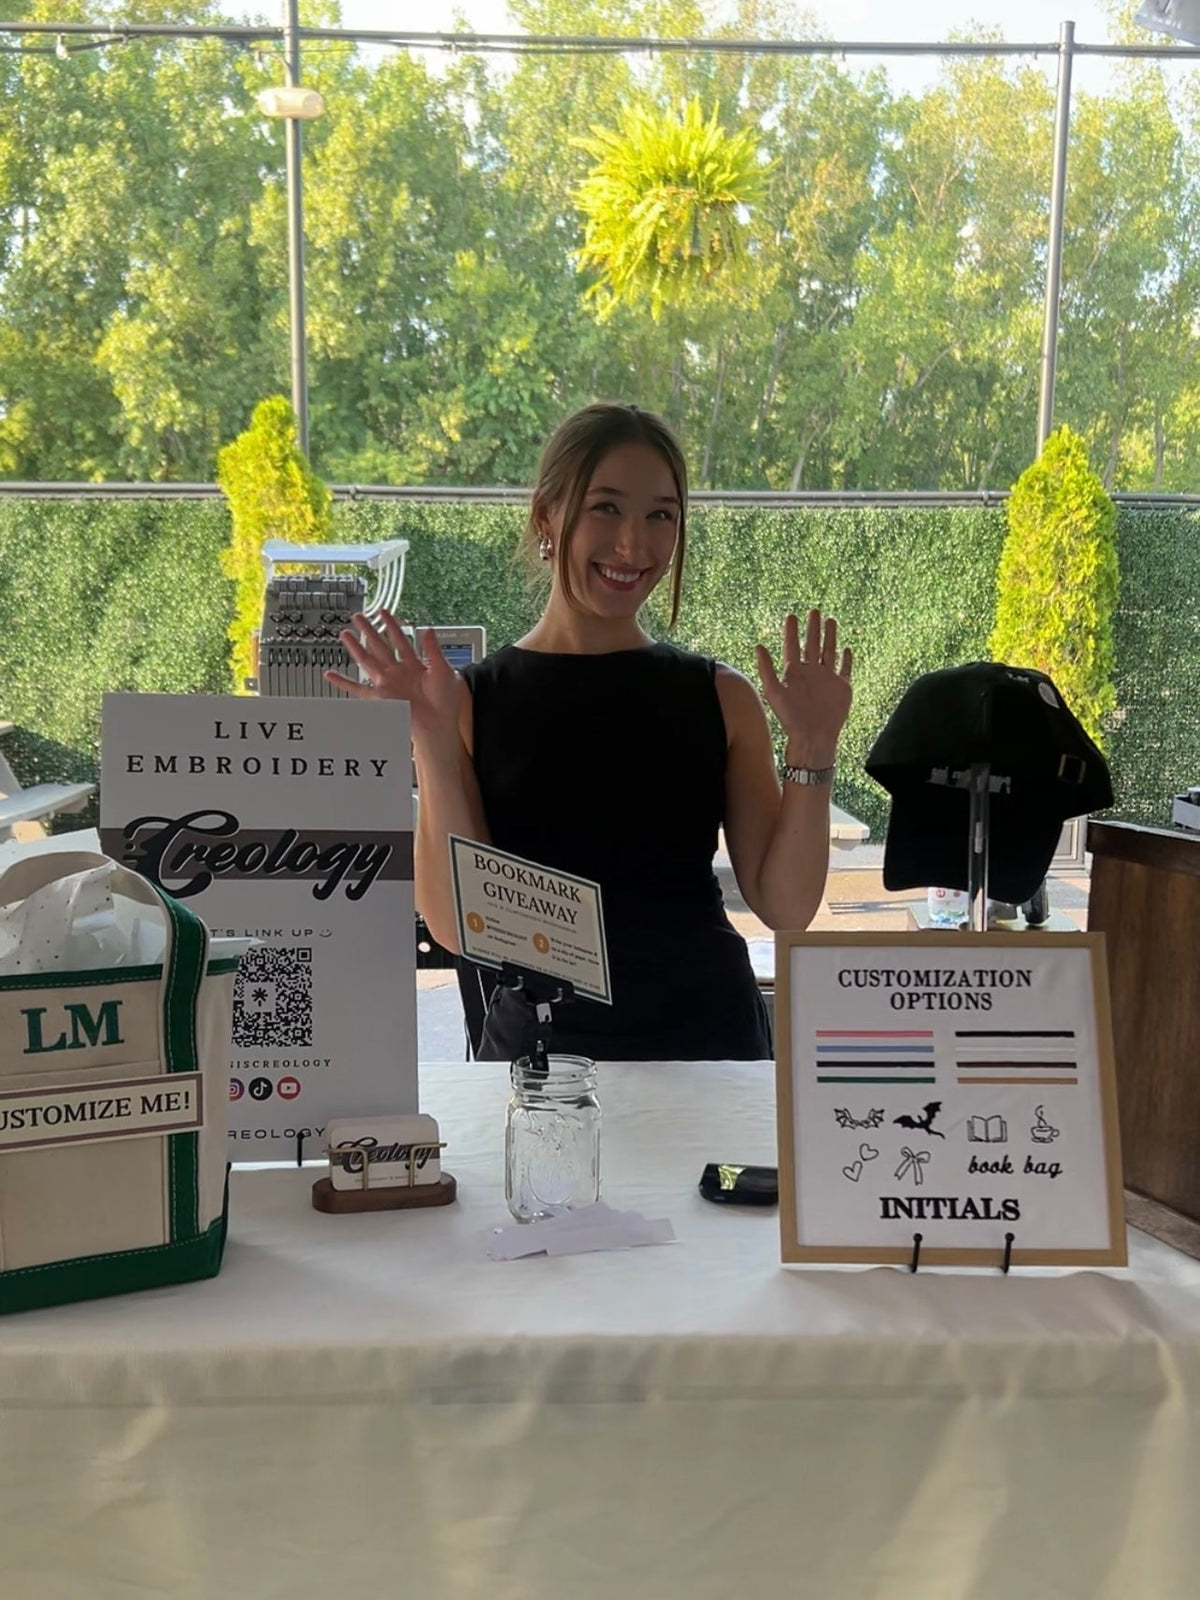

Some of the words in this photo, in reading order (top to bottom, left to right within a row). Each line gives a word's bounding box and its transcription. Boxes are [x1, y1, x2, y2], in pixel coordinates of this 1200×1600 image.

[214, 721, 305, 742] LIVE
[126, 754, 389, 777] EMBROIDERY
[122, 809, 393, 901] Creology
[473, 853, 582, 903] BOOKMARK
[483, 881, 578, 925] GIVEAWAY
[244, 929, 283, 937] LINK
[291, 929, 314, 937] UP
[837, 969, 1033, 988] CUSTOMIZATION
[889, 991, 993, 1011] OPTIONS
[20, 1000, 125, 1055] LM
[140, 1091, 190, 1115] ME!
[967, 1154, 1014, 1175] book
[1022, 1154, 1064, 1179] bag
[878, 1196, 1022, 1222] INITIALS
